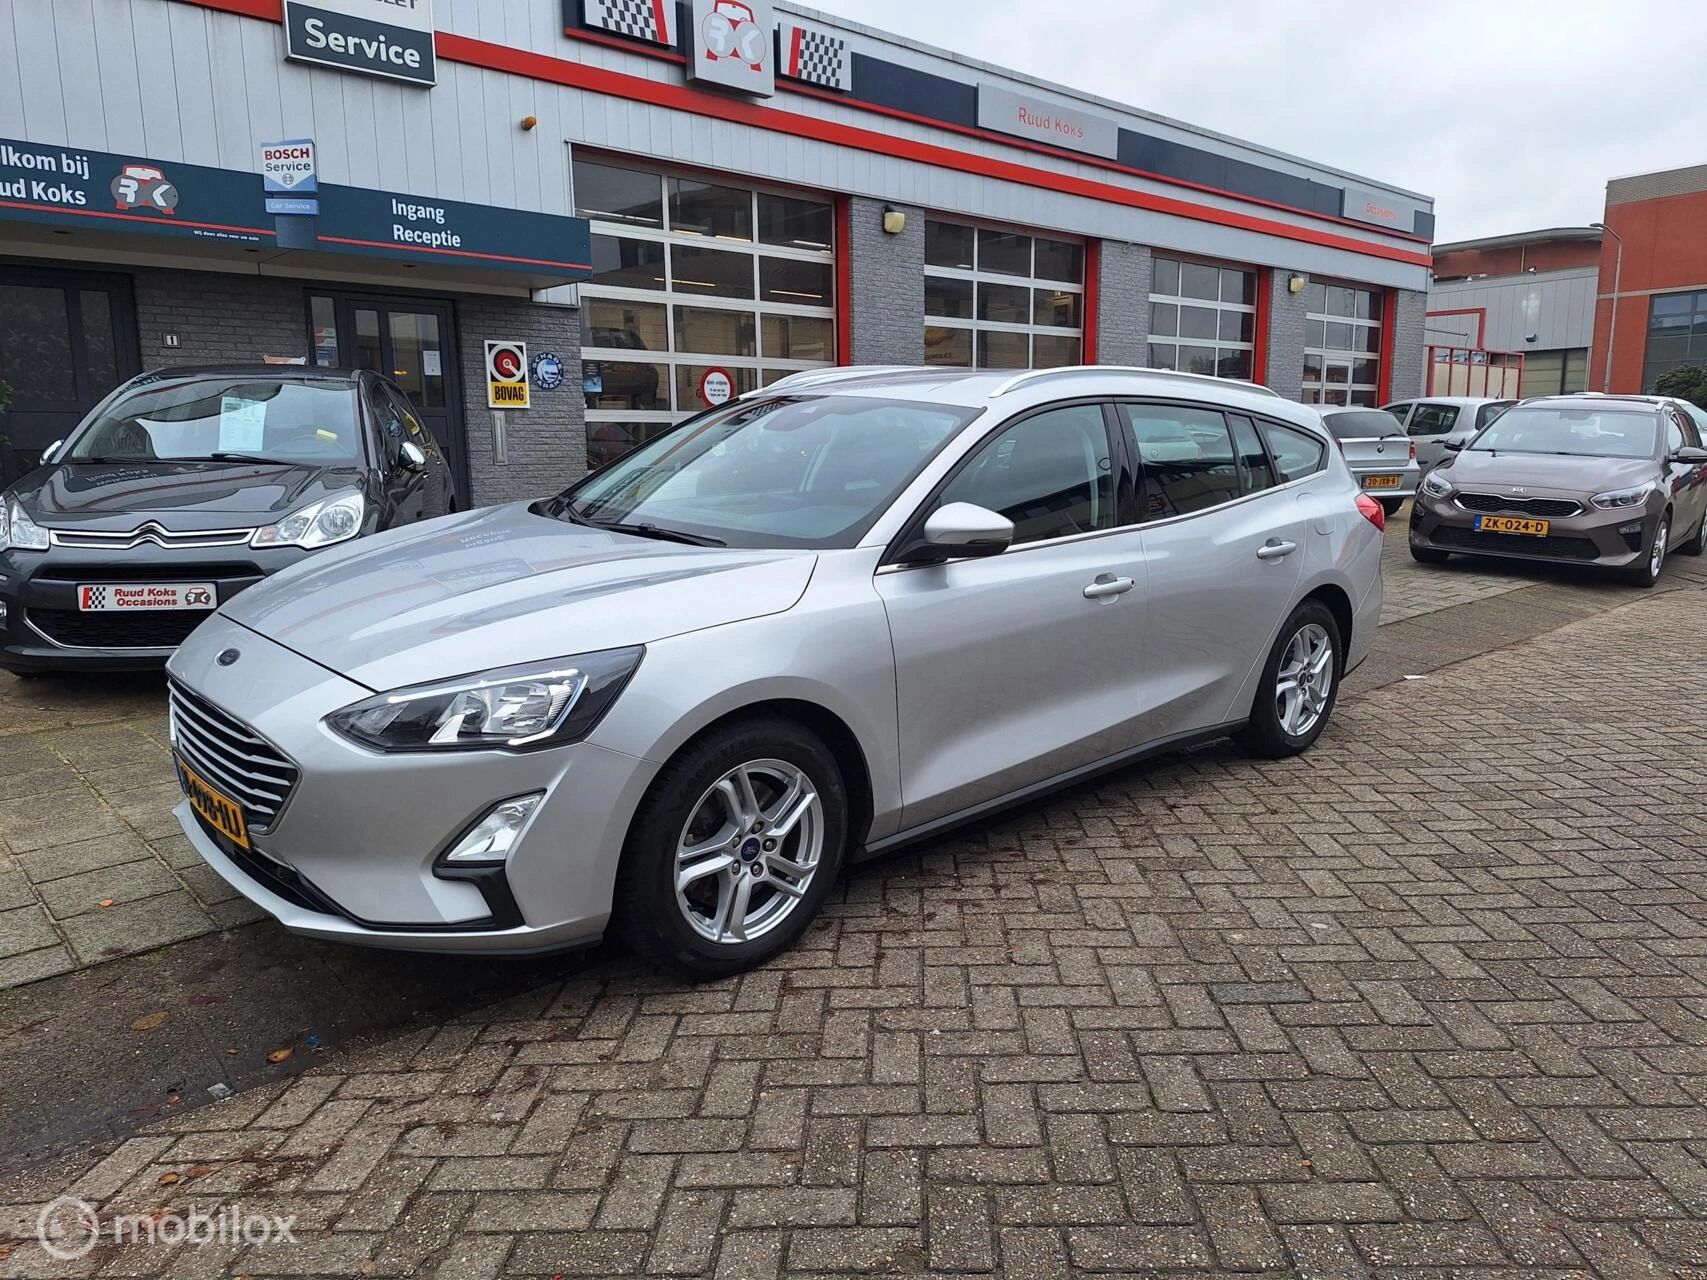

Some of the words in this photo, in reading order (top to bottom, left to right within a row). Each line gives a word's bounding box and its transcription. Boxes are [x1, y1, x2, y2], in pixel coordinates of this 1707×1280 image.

[304, 17, 421, 69] Service
[1018, 106, 1051, 130] Ruud
[1055, 116, 1084, 138] Koks
[0, 145, 57, 172] lkom
[61, 153, 91, 180] bij
[264, 148, 310, 161] BOSCH
[265, 161, 311, 172] Service
[32, 180, 87, 206] Koks
[391, 198, 446, 225] Ingang
[392, 224, 461, 248] Receptie
[532, 353, 563, 370] SCHADE
[494, 385, 525, 401] BOVAG
[1484, 517, 1544, 533] ZK-024-D
[114, 588, 144, 598] Ruud
[147, 588, 177, 597] Koks
[116, 597, 178, 607] Occasions
